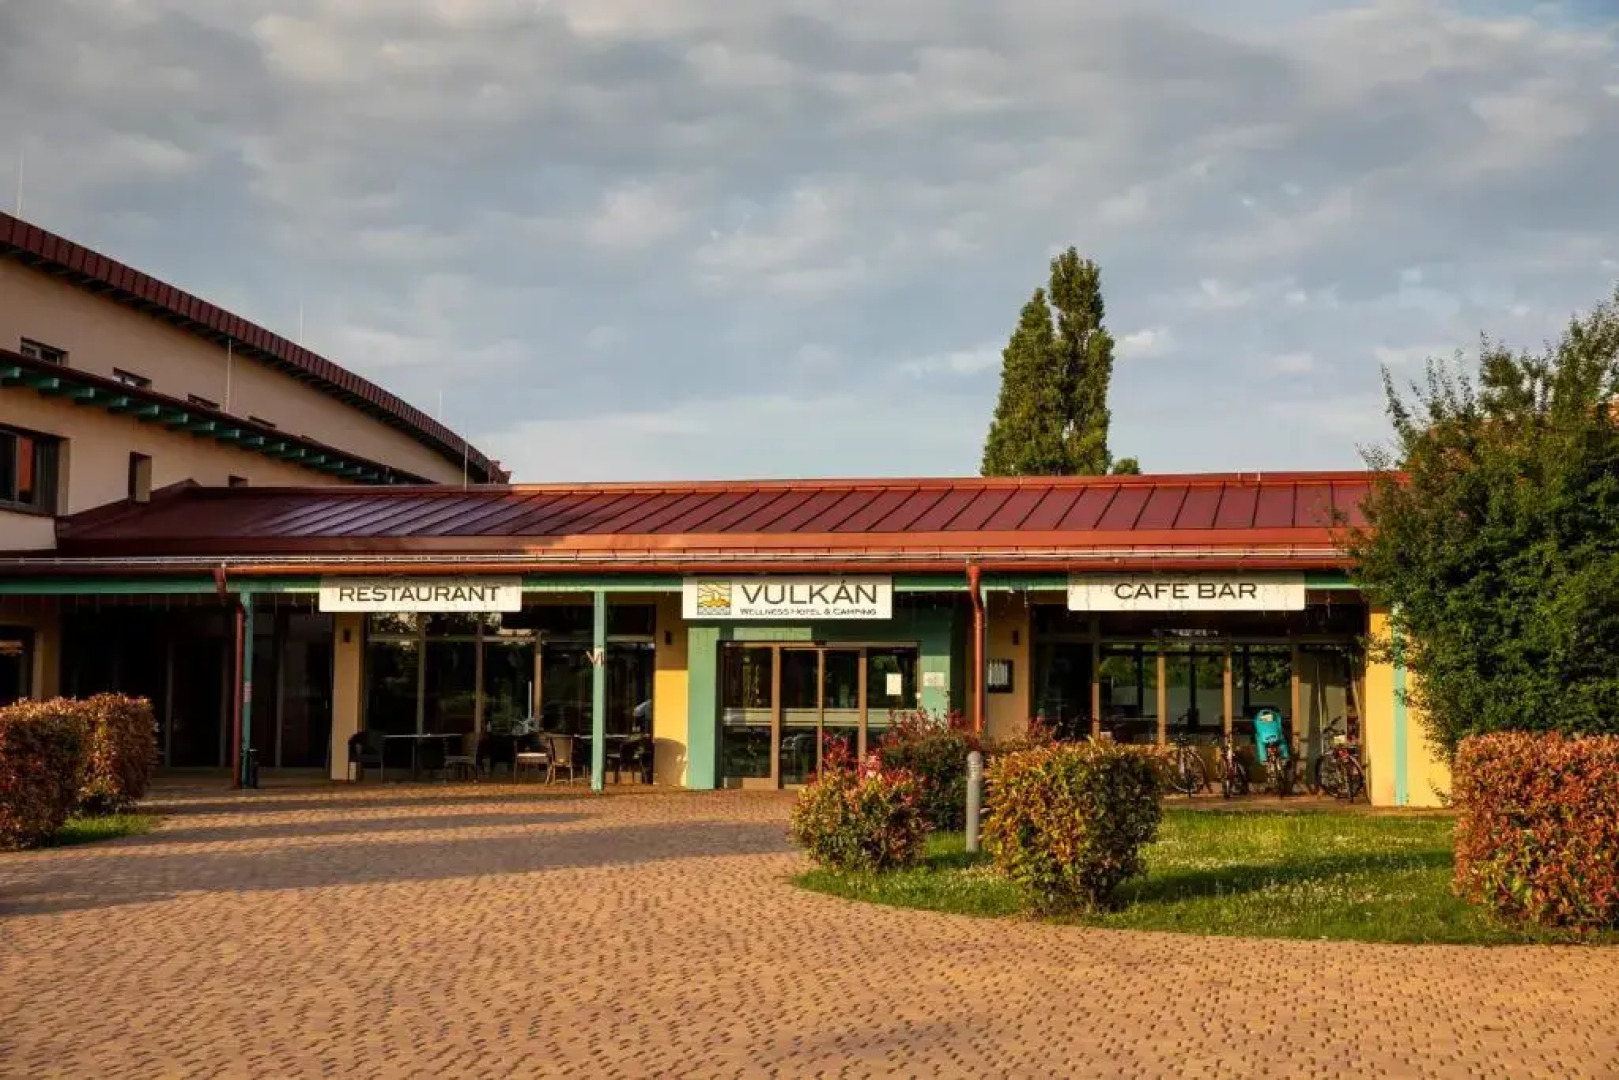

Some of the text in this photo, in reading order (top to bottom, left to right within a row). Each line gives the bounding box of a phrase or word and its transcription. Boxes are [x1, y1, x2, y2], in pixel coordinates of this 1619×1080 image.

[339, 586, 500, 602] RESTAURANT
[741, 579, 877, 604] VULKÁN
[1114, 582, 1257, 600] CAFE BAR
[824, 608, 831, 616] &
